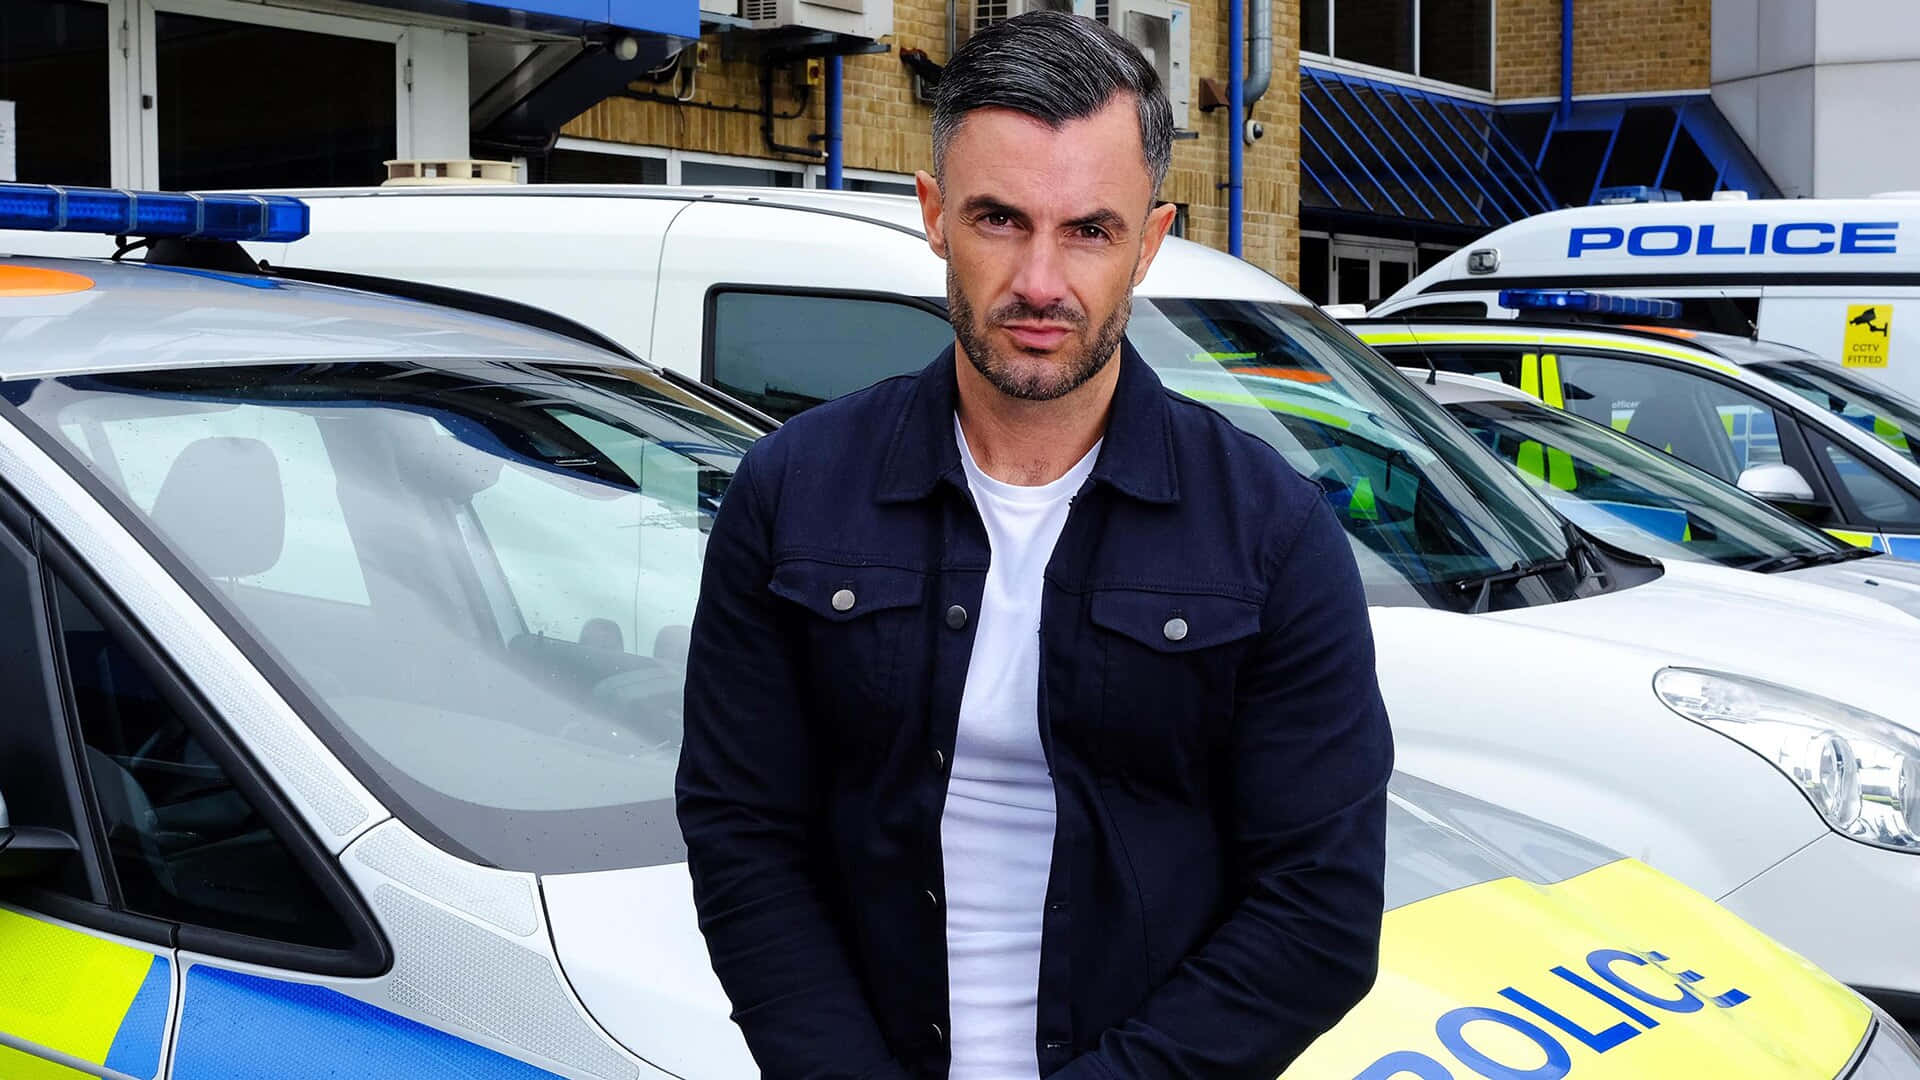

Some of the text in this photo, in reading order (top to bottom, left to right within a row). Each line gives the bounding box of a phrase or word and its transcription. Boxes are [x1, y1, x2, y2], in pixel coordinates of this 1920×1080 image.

[1567, 221, 1899, 258] POLICE
[1852, 344, 1880, 352] CCTV
[1847, 355, 1882, 364] FITTED
